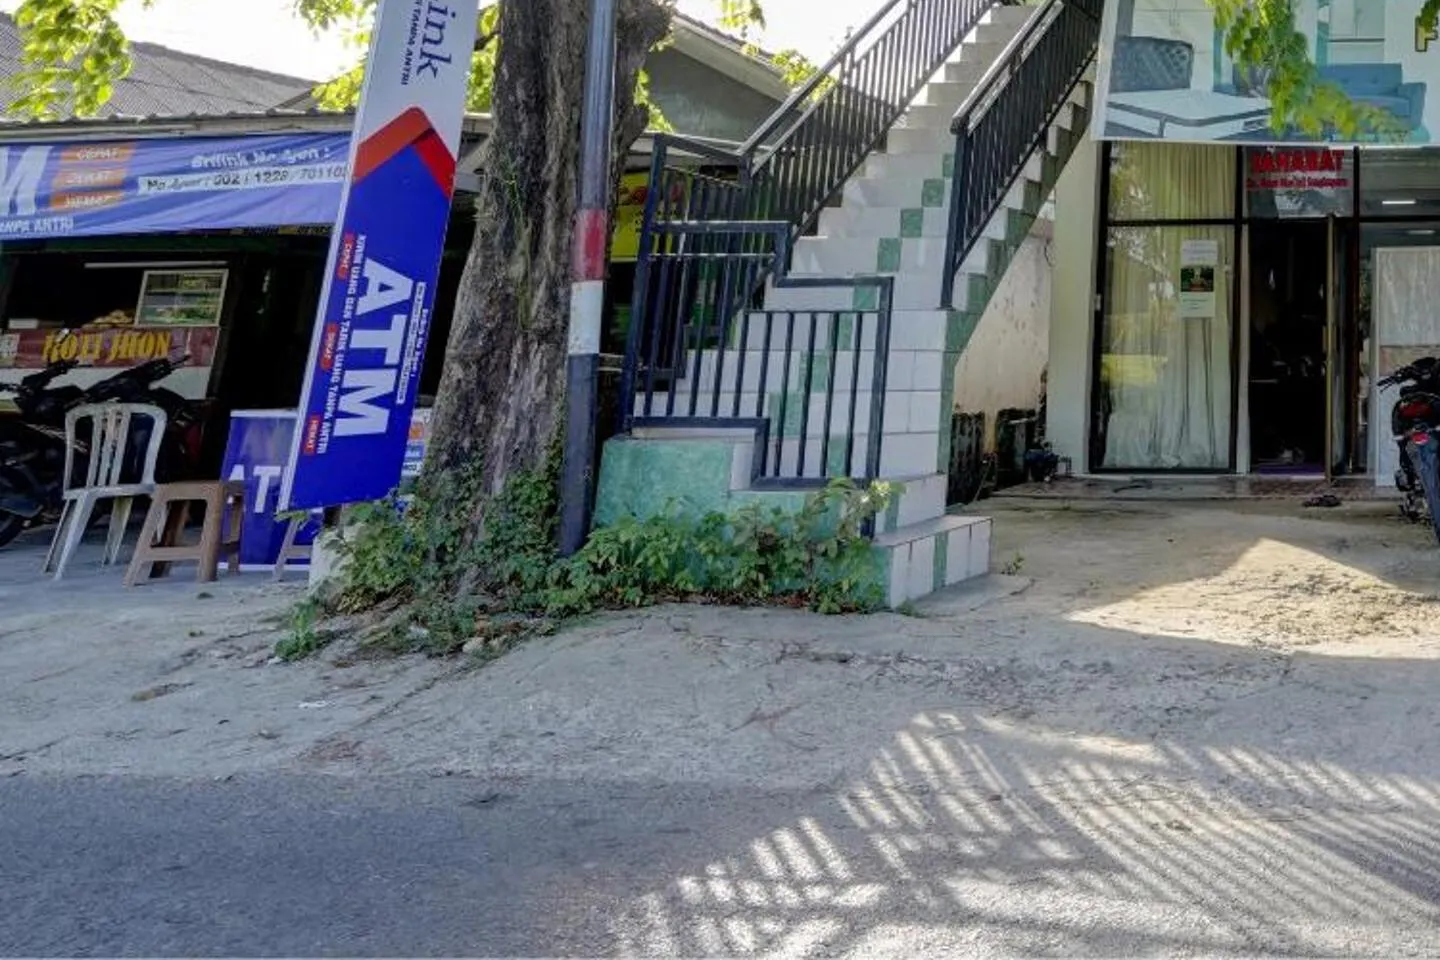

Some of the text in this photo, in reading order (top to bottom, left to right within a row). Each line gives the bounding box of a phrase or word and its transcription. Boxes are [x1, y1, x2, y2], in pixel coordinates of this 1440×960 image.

[407, 7, 422, 46] TANPA
[401, 50, 414, 86] ANTRI
[333, 257, 414, 437] ATM
[335, 320, 351, 352] TARIK
[330, 354, 345, 383] UANG
[324, 385, 340, 420] TANPA
[316, 421, 332, 454] ANTRI
